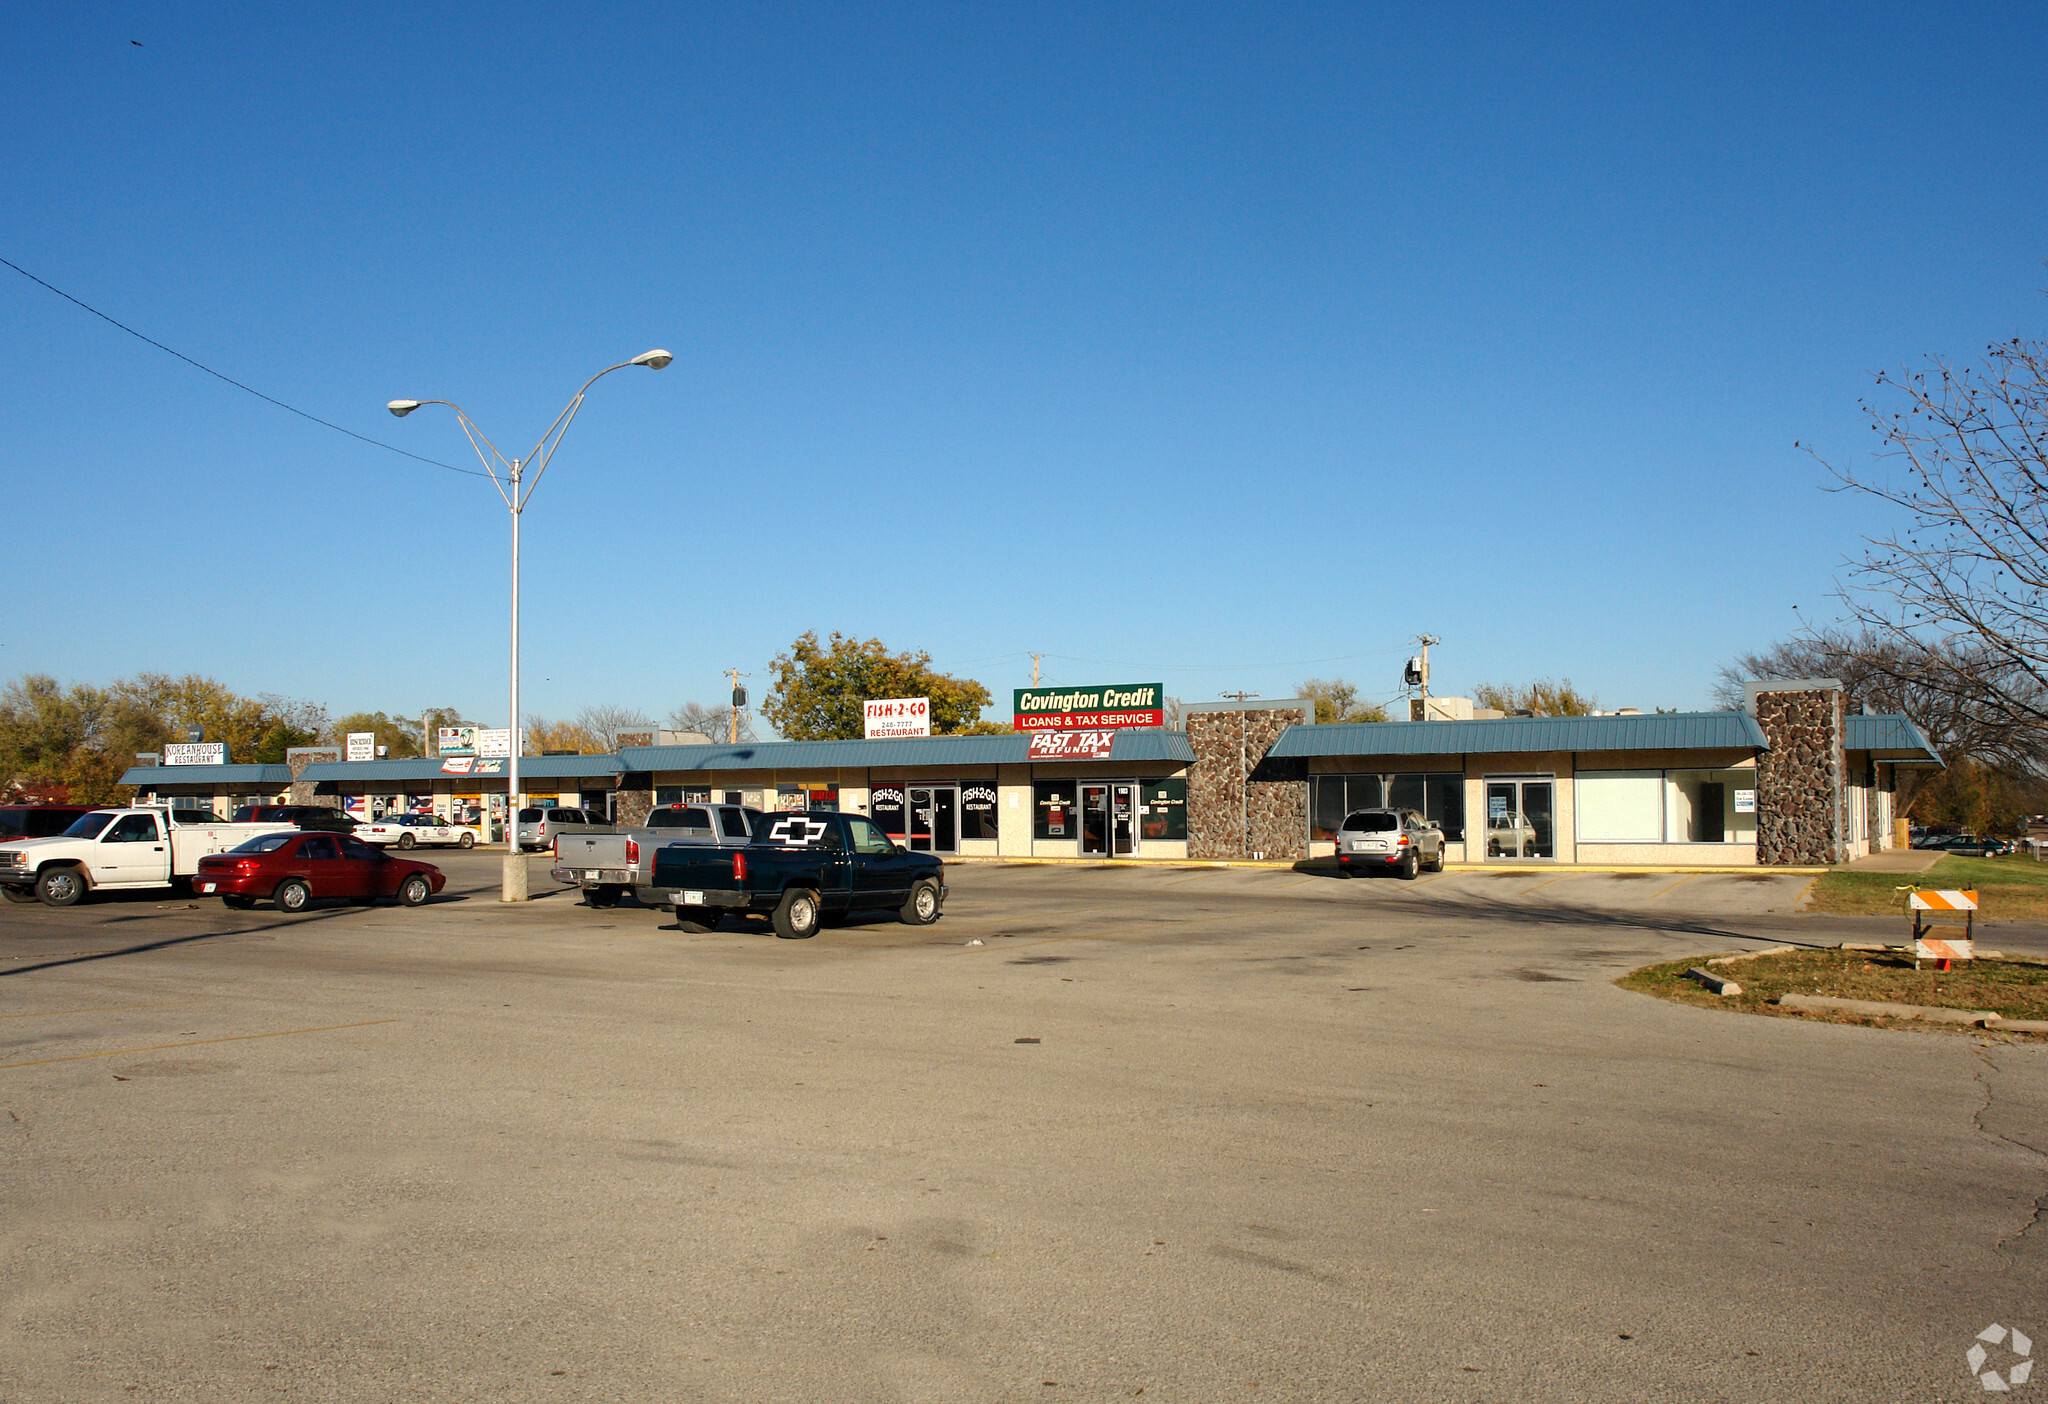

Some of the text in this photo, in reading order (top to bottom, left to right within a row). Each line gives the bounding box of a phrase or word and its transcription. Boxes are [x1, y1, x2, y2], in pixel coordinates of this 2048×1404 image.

[1020, 687, 1155, 713] Covington Credit
[1022, 713, 1153, 727] LOANS & TAX SERVICE
[870, 728, 925, 737] RESTAURANT
[1030, 732, 1115, 749] FAST TAX
[1040, 746, 1098, 754] REFUNDS
[174, 755, 214, 764] RESTAURANT
[872, 788, 904, 805] FISH-2-GO
[962, 787, 997, 805] FISH-2-GO
[966, 803, 992, 811] RESTAURANT
